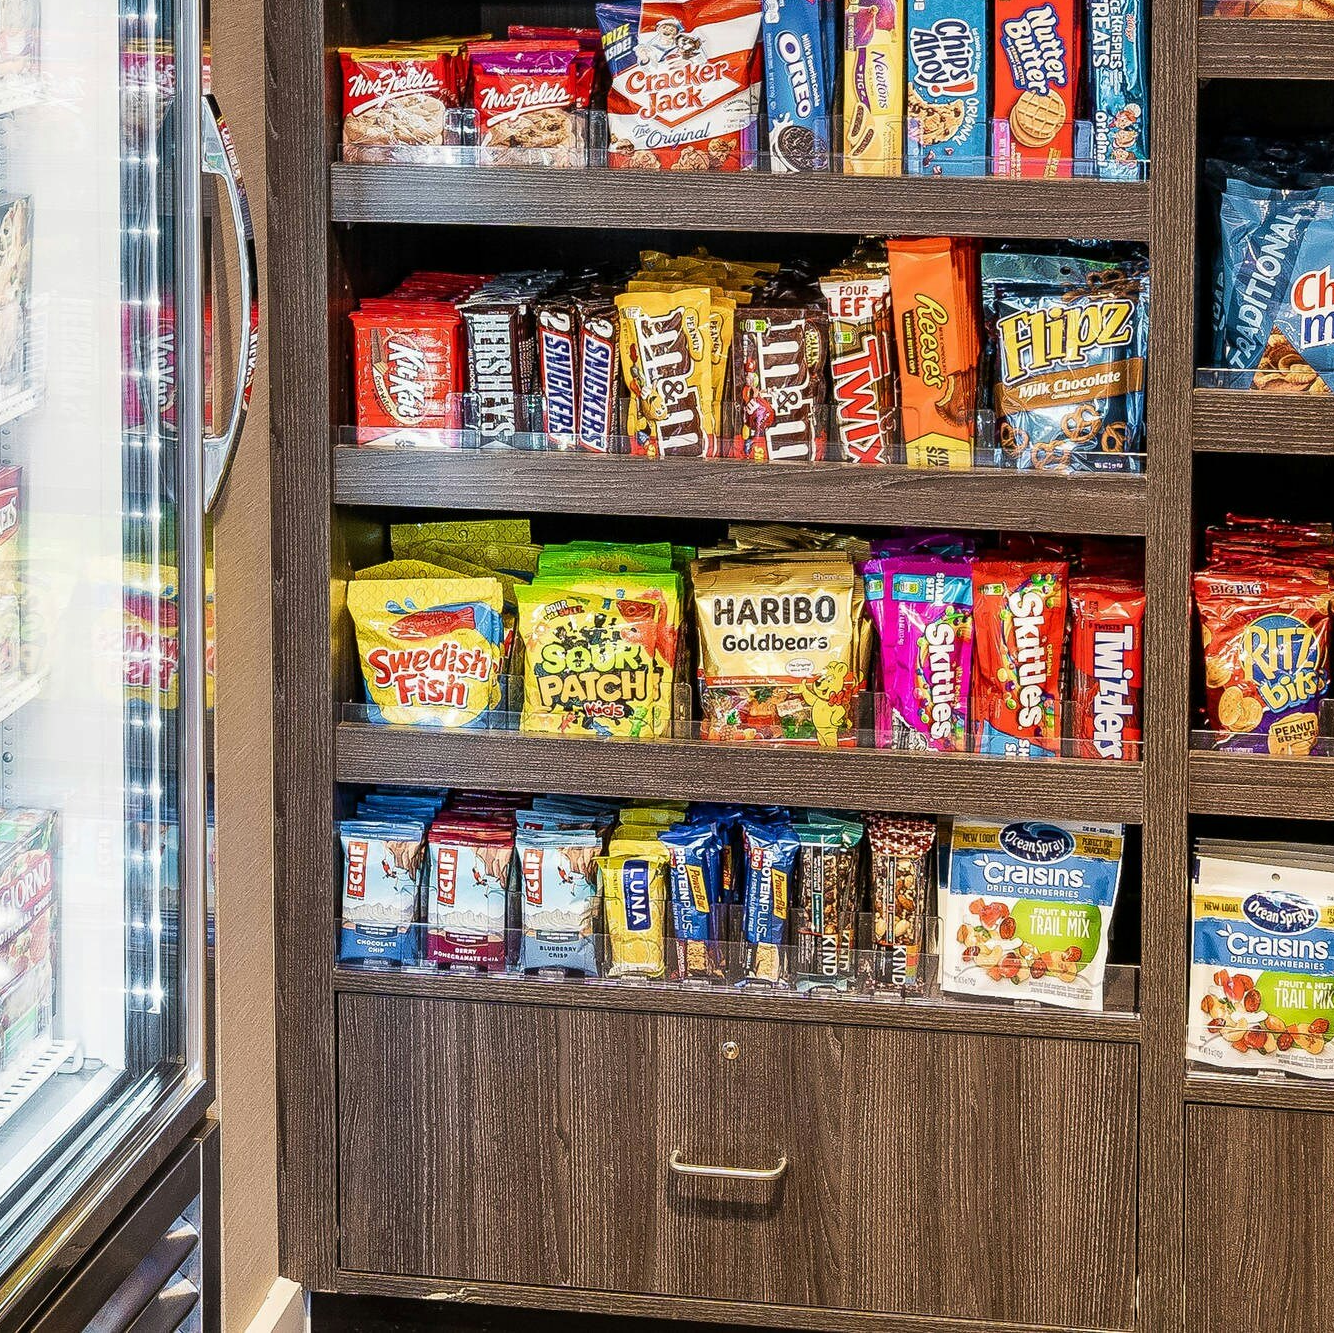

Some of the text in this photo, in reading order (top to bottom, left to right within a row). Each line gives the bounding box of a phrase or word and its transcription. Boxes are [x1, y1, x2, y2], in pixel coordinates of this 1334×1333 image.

[935, 22, 973, 80] Chips
[1005, 18, 1049, 94] Butter
[1027, 5, 1066, 85] Nutter
[1111, 14, 1124, 69] KRISPIES
[625, 61, 728, 95] Cracker
[777, 32, 810, 119] OREO
[870, 52, 889, 109] Newtons
[640, 87, 704, 119] Jack
[952, 98, 979, 147] ORIGINAL
[633, 122, 709, 148] The Original
[839, 286, 868, 296] FOUR
[1230, 213, 1302, 369] TRADITIONAL
[687, 316, 699, 352] PEANUT
[915, 293, 949, 389] Reese's
[999, 303, 1133, 381] Flipz
[472, 314, 515, 437] HERSHEY'S
[545, 333, 573, 442] SNICKERS
[579, 338, 610, 449] SNICKERS
[1019, 372, 1120, 399] Milk Chocolate
[545, 601, 567, 613] SOUR
[713, 595, 835, 627] HARIBO
[541, 643, 641, 672] SOUR
[723, 634, 828, 651] Goldbears
[1009, 591, 1048, 730] Skittles
[1244, 626, 1315, 683] RITZ
[369, 645, 490, 687] Swedish
[924, 623, 956, 738] Skittles
[395, 673, 468, 706] Fish
[539, 671, 648, 706] PATCH
[1094, 625, 1135, 759] Twizzlers
[1262, 671, 1318, 708] bits
[1275, 721, 1315, 736] PEANUT
[1007, 831, 1065, 855] Ocean Spray
[348, 843, 366, 884] CLIF
[439, 850, 457, 891] CLIF
[525, 850, 542, 890] CLIF
[629, 868, 646, 925] LUNA
[689, 867, 703, 911] PowerBar
[1017, 887, 1078, 898] CRANBERRIES
[1030, 916, 1089, 938] TRAIL MIX
[1248, 901, 1280, 923] Ocean
[823, 935, 837, 976] KIND
[893, 946, 906, 985] KIND
[1231, 956, 1325, 970] DRIED CRANBERRIES
[1275, 988, 1334, 1009] TRAIL MIX
[1278, 980, 1303, 988] FRUIT
[1315, 982, 1333, 990] NUT
